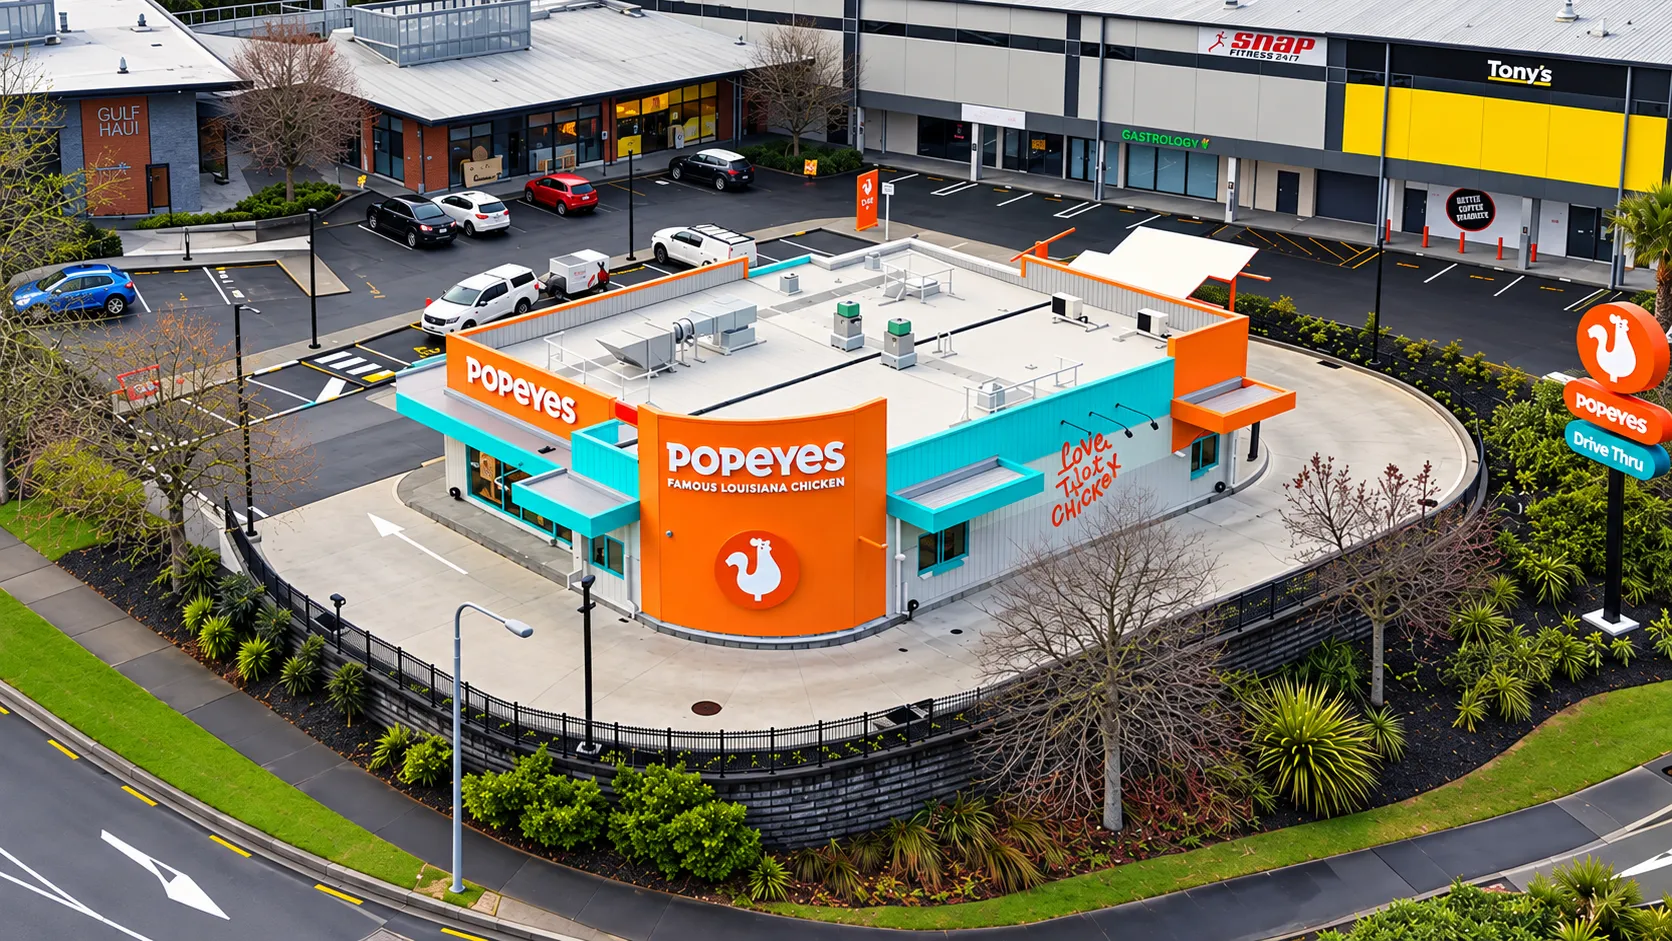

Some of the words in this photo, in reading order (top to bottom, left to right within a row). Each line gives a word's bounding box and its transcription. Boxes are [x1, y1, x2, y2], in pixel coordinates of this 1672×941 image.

[1229, 49, 1273, 60] FITNESS
[1487, 59, 1553, 85] Tony's
[97, 105, 140, 122] GULF
[99, 121, 139, 137] HAUI
[1121, 129, 1199, 149] GASTROLOGY
[1573, 431, 1610, 457] Drive
[1611, 445, 1644, 472] Thru
[667, 478, 718, 492] FAMOUS
[721, 482, 788, 494] LOUISIANA
[791, 477, 845, 492] CHICKEN
